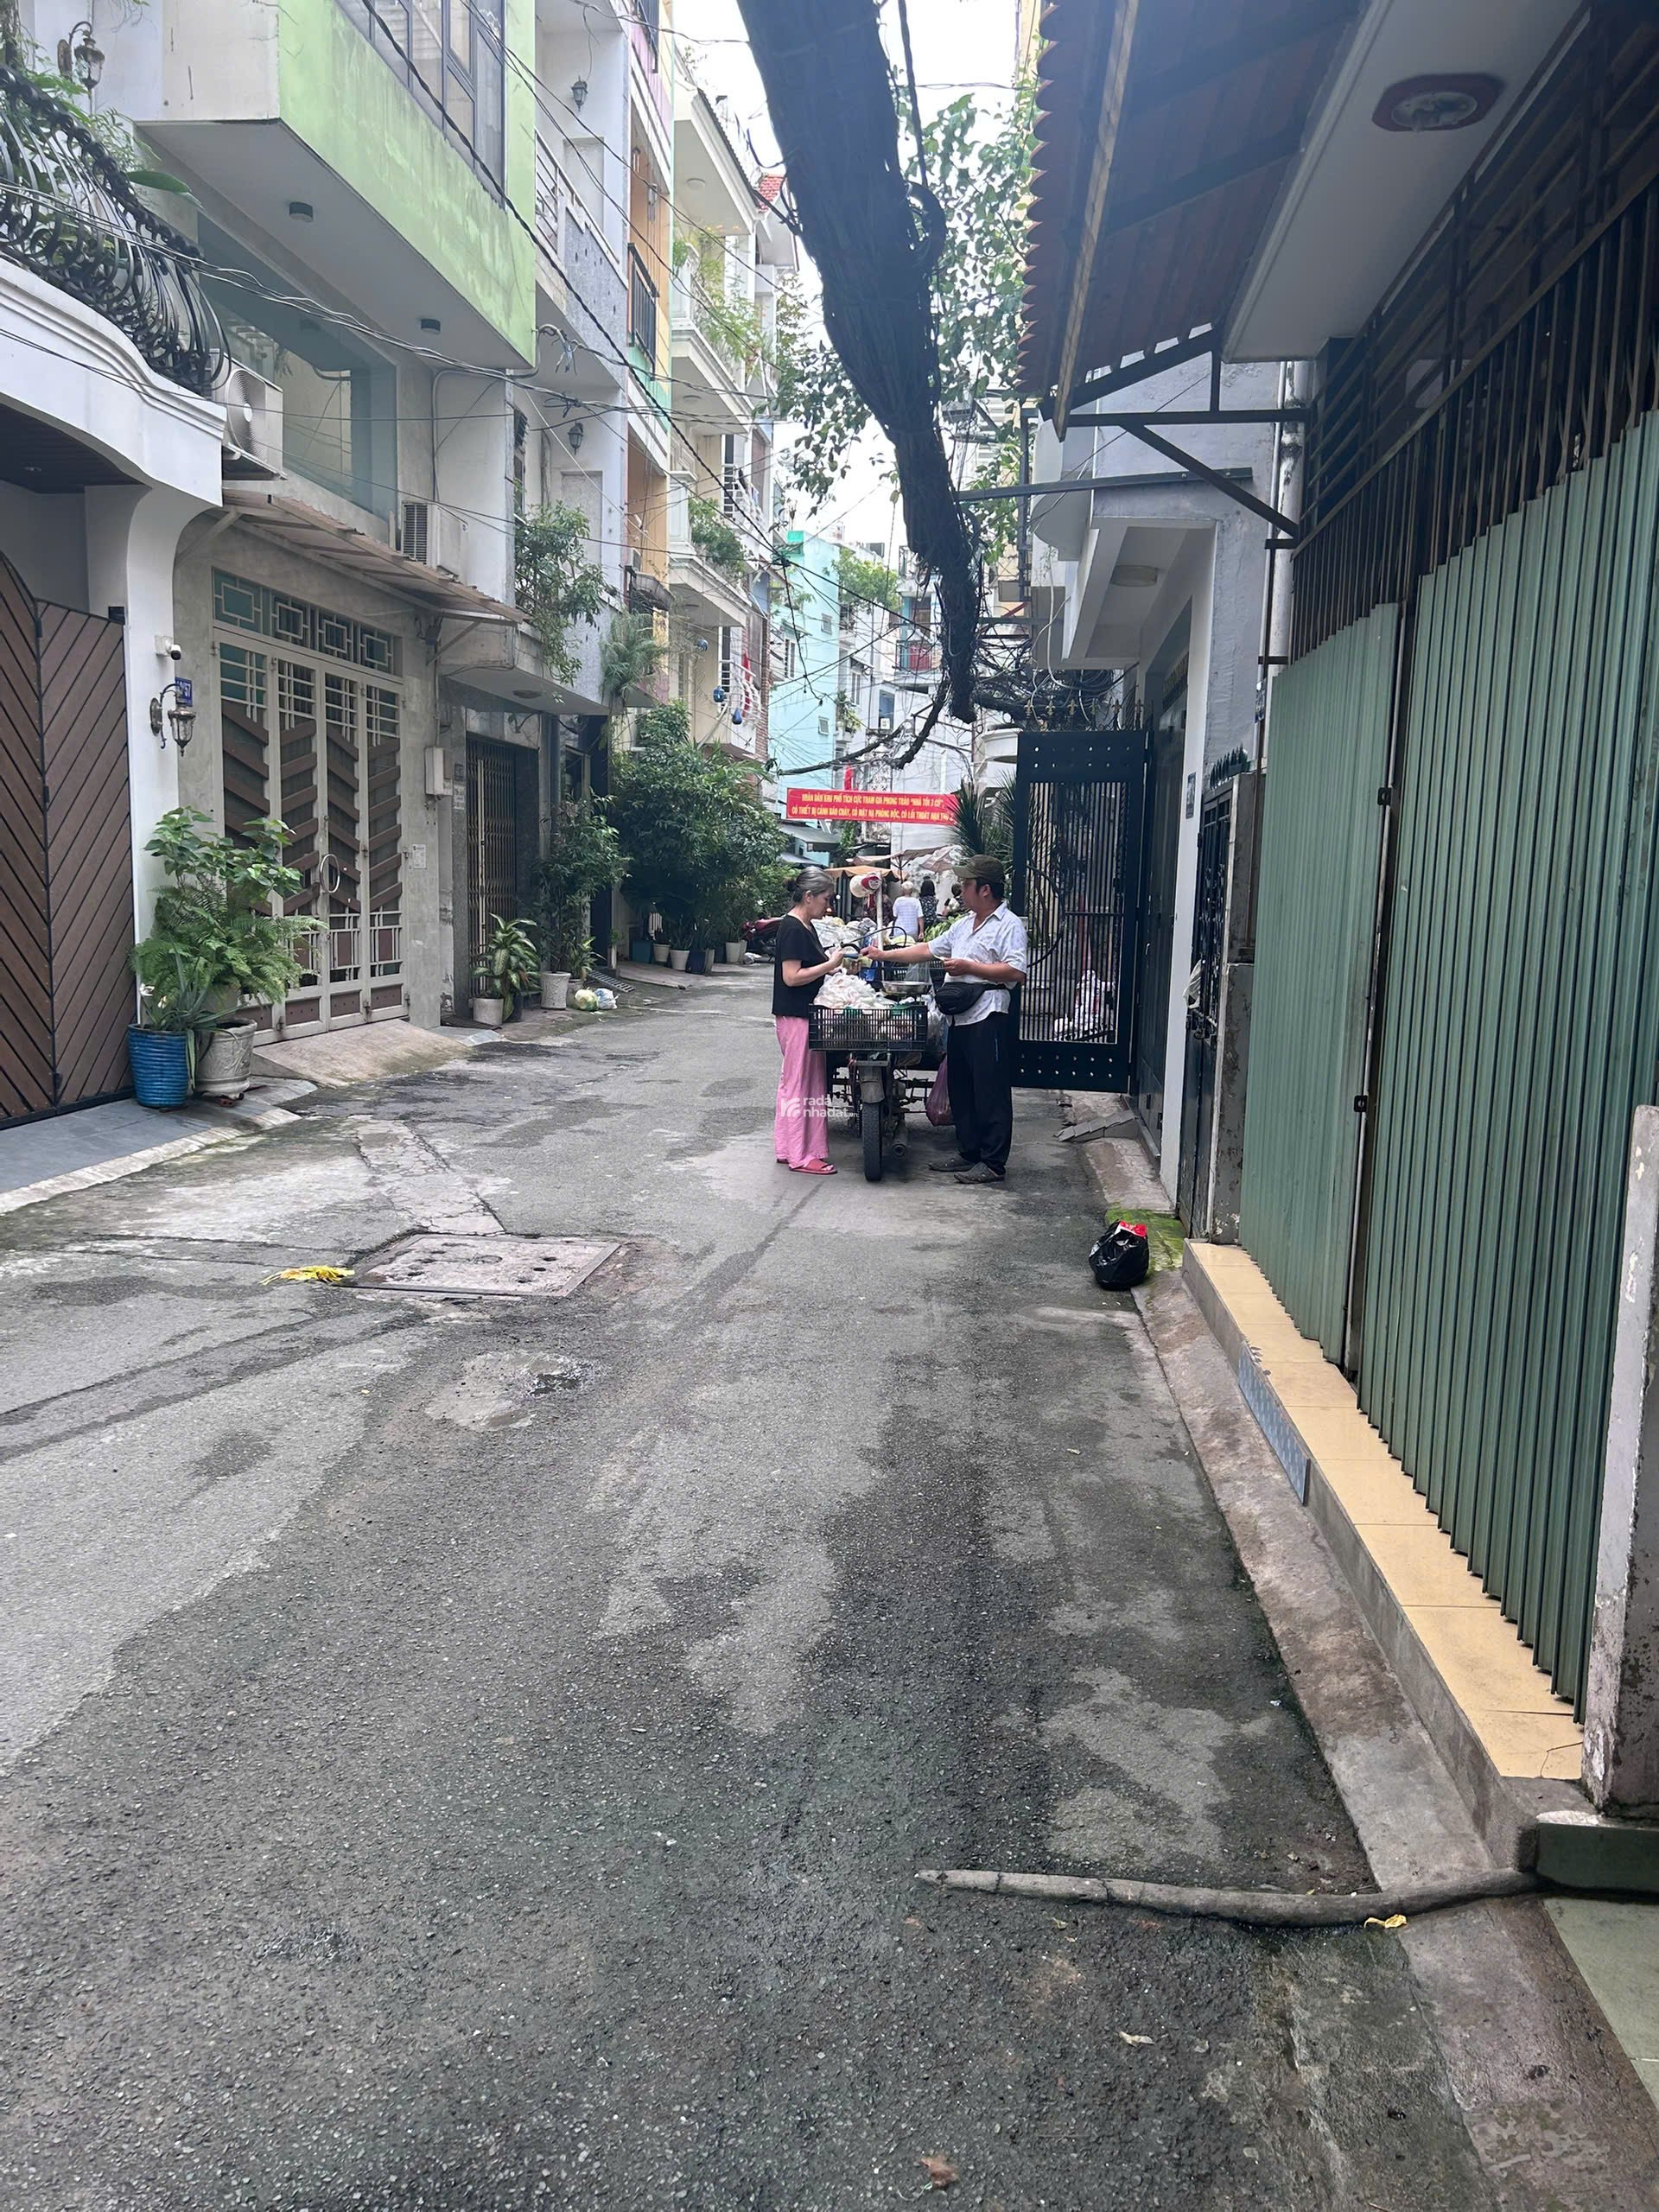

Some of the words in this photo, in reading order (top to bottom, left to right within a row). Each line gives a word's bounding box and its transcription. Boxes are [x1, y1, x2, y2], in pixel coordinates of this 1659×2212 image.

[814, 792, 823, 802] DÂN
[833, 792, 842, 803] PHỐ
[843, 794, 852, 803] TÍCH
[853, 795, 862, 804] CỰC
[863, 796, 875, 804] THAM
[883, 797, 897, 805] PHONG
[898, 796, 910, 805] TRÀO
[791, 804, 798, 814] CÓ
[799, 804, 810, 814] THIẾT
[812, 807, 816, 816] BỊ
[817, 805, 828, 815] CẢNH
[829, 806, 837, 815] BÁO
[852, 807, 857, 816] CÓ
[875, 808, 889, 818] PHÒNG
[901, 809, 907, 818] CÓ
